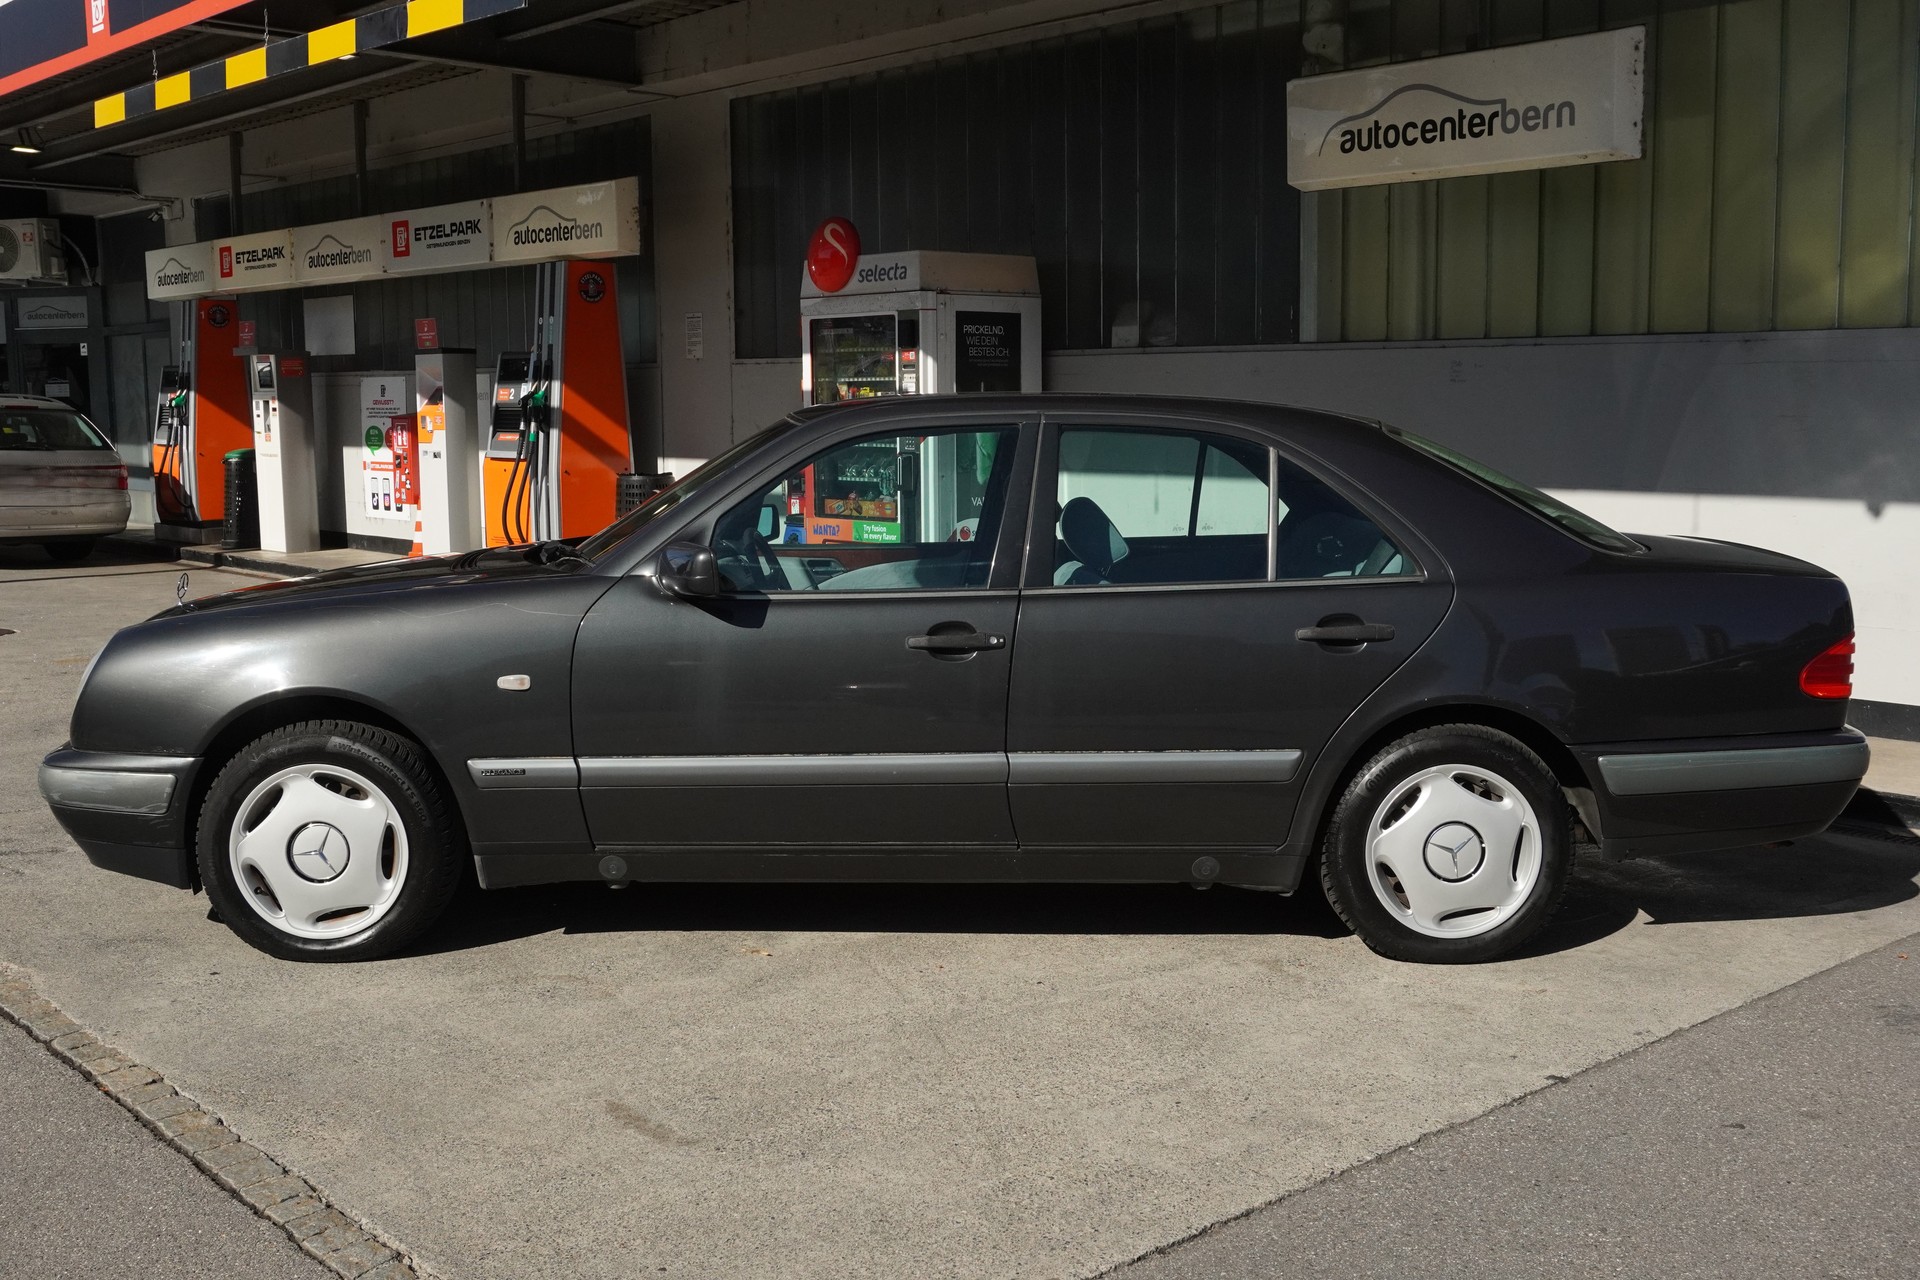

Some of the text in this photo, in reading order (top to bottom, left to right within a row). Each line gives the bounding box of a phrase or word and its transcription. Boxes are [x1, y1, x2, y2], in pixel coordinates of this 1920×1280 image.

[1340, 98, 1576, 155] autocenterbern
[414, 219, 482, 241] ETZELPARK
[513, 219, 603, 245] autocenterbern
[235, 246, 285, 264] ETZELPARK
[308, 246, 372, 269] autocenterbern
[157, 267, 205, 287] autocenterbern
[858, 262, 907, 283] selecta
[963, 324, 1005, 336] PRICKELND,
[966, 336, 999, 345] WIE DEIN
[968, 346, 995, 357] BESTES
[509, 388, 515, 400] 2
[863, 524, 887, 533] Try fusion
[869, 533, 882, 541] every
[882, 532, 897, 541] flavor
